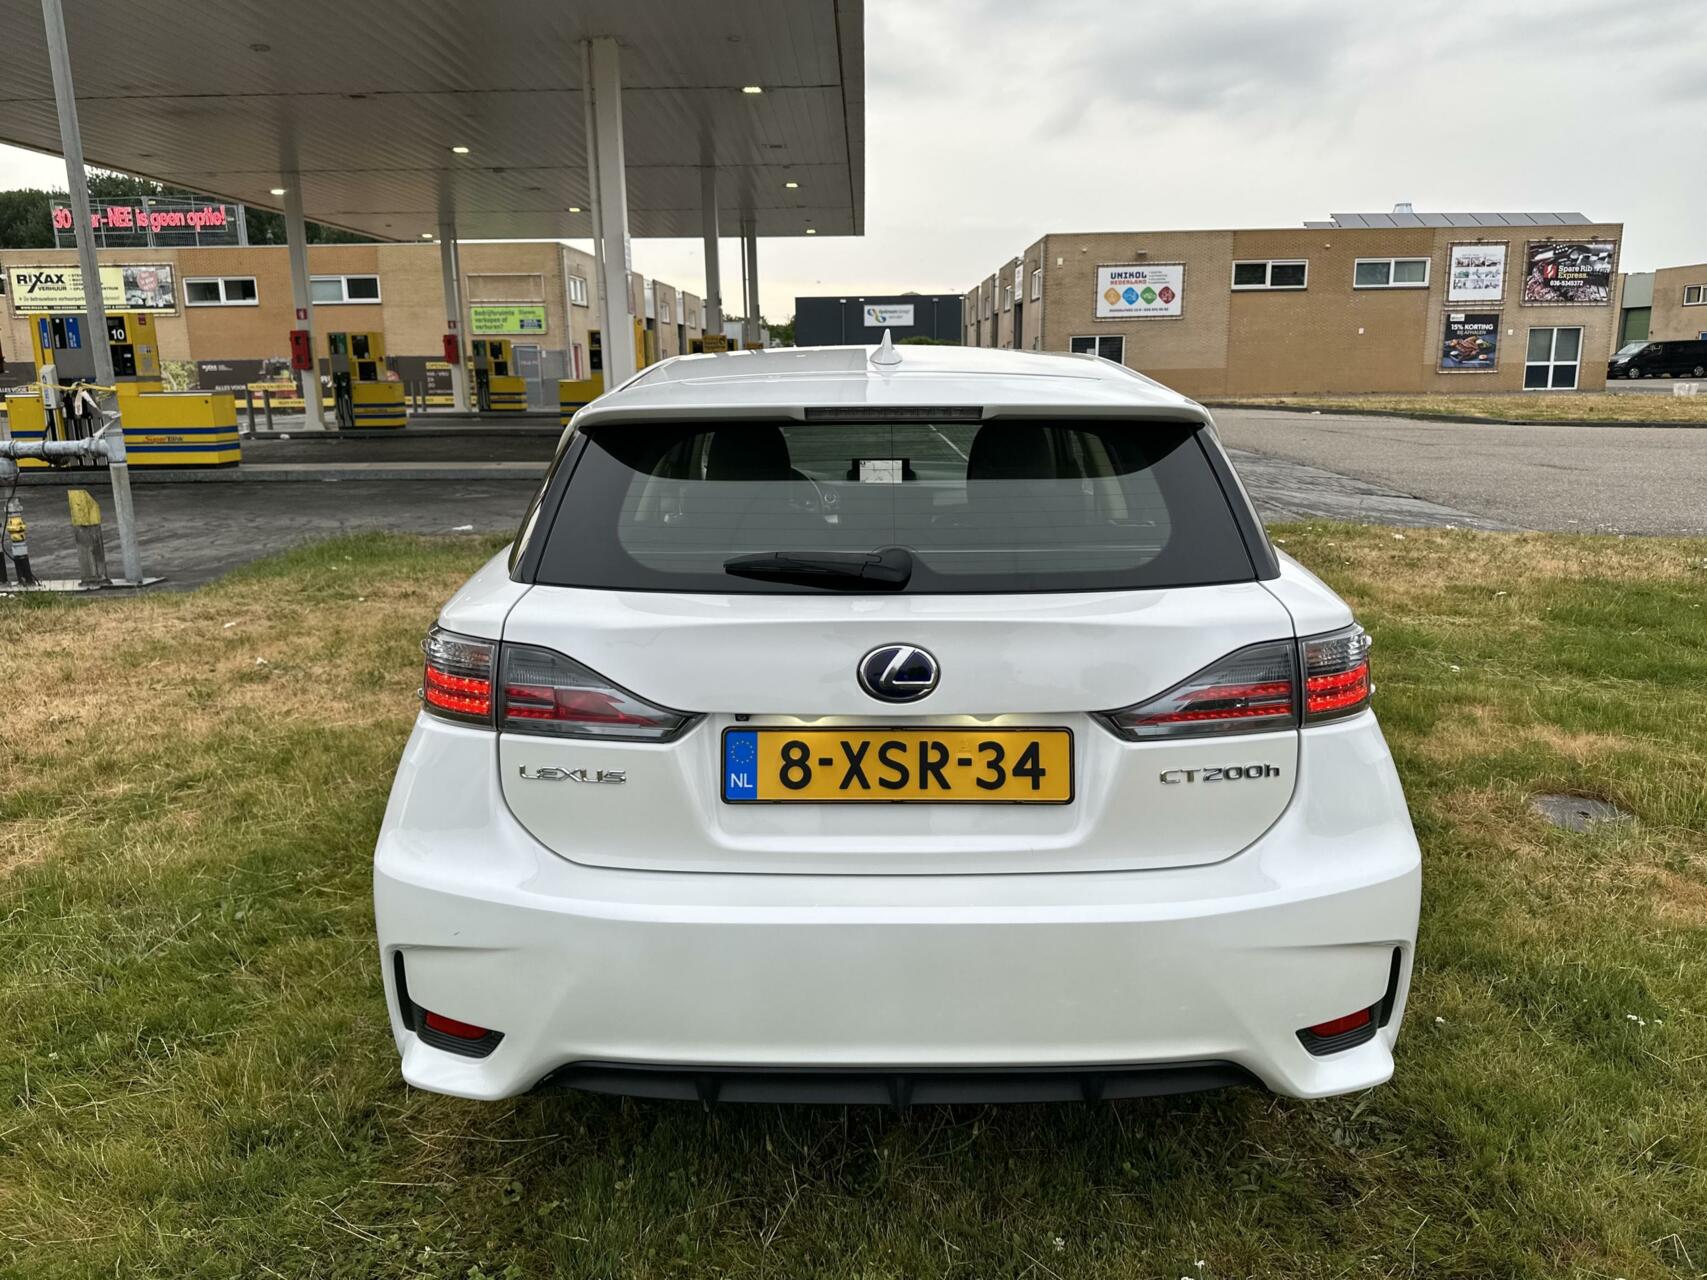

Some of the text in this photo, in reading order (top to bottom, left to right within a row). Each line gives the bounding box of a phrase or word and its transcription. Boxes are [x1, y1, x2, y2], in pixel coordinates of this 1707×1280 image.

[53, 207, 71, 228] 30
[135, 207, 148, 227] is
[150, 211, 185, 232] geen
[186, 205, 226, 232] optie!
[1558, 265, 1580, 273] Spare
[111, 329, 125, 340] 10
[519, 764, 627, 785] LEXUS
[779, 740, 1046, 791] 8-XSR-34
[730, 773, 753, 789] NL
